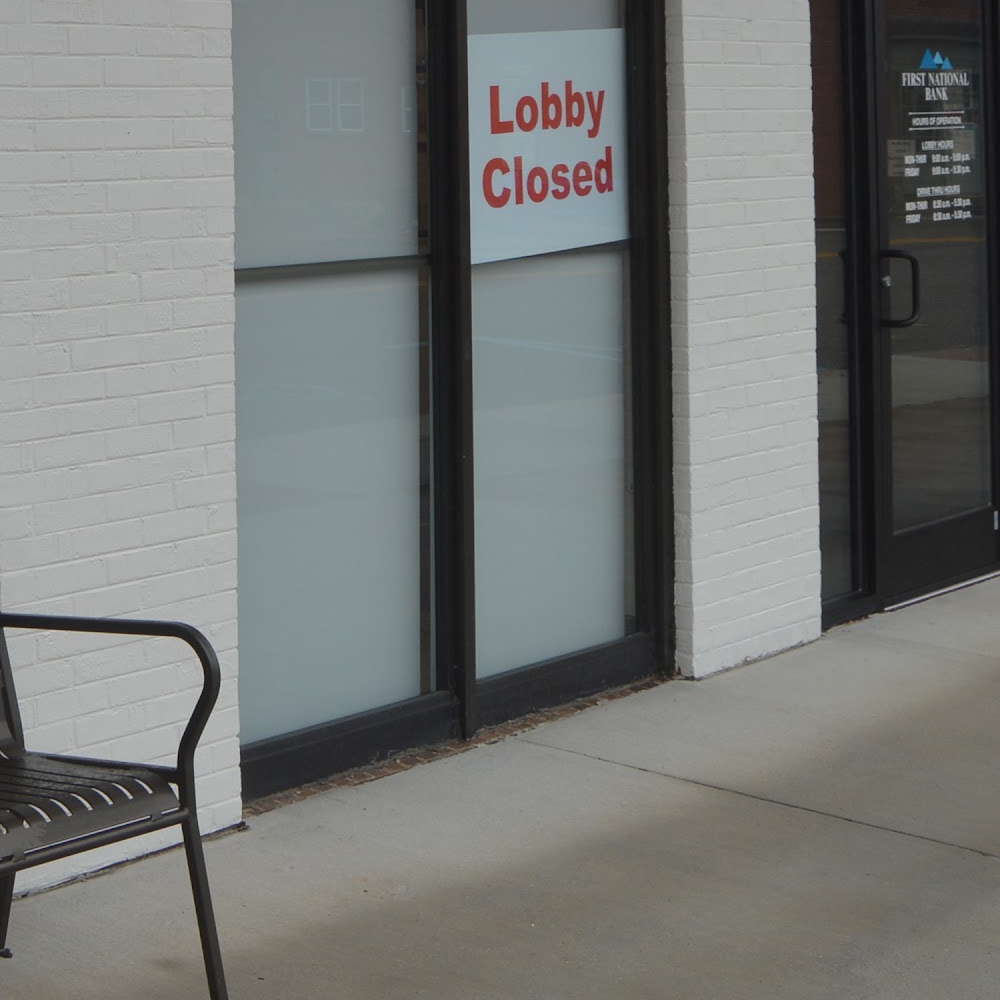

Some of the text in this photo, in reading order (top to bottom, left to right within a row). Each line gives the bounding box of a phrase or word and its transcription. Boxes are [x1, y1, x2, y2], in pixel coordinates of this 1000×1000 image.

[902, 72, 970, 87] FIRST NATIONAL
[925, 87, 948, 101] BANK
[489, 80, 605, 138] Lobby
[912, 116, 962, 126] HOURS OF OPERATION
[922, 140, 953, 150] LOBBY HOURS
[482, 146, 614, 208] Closed
[917, 185, 960, 197] DRIVE THRU HOURS
